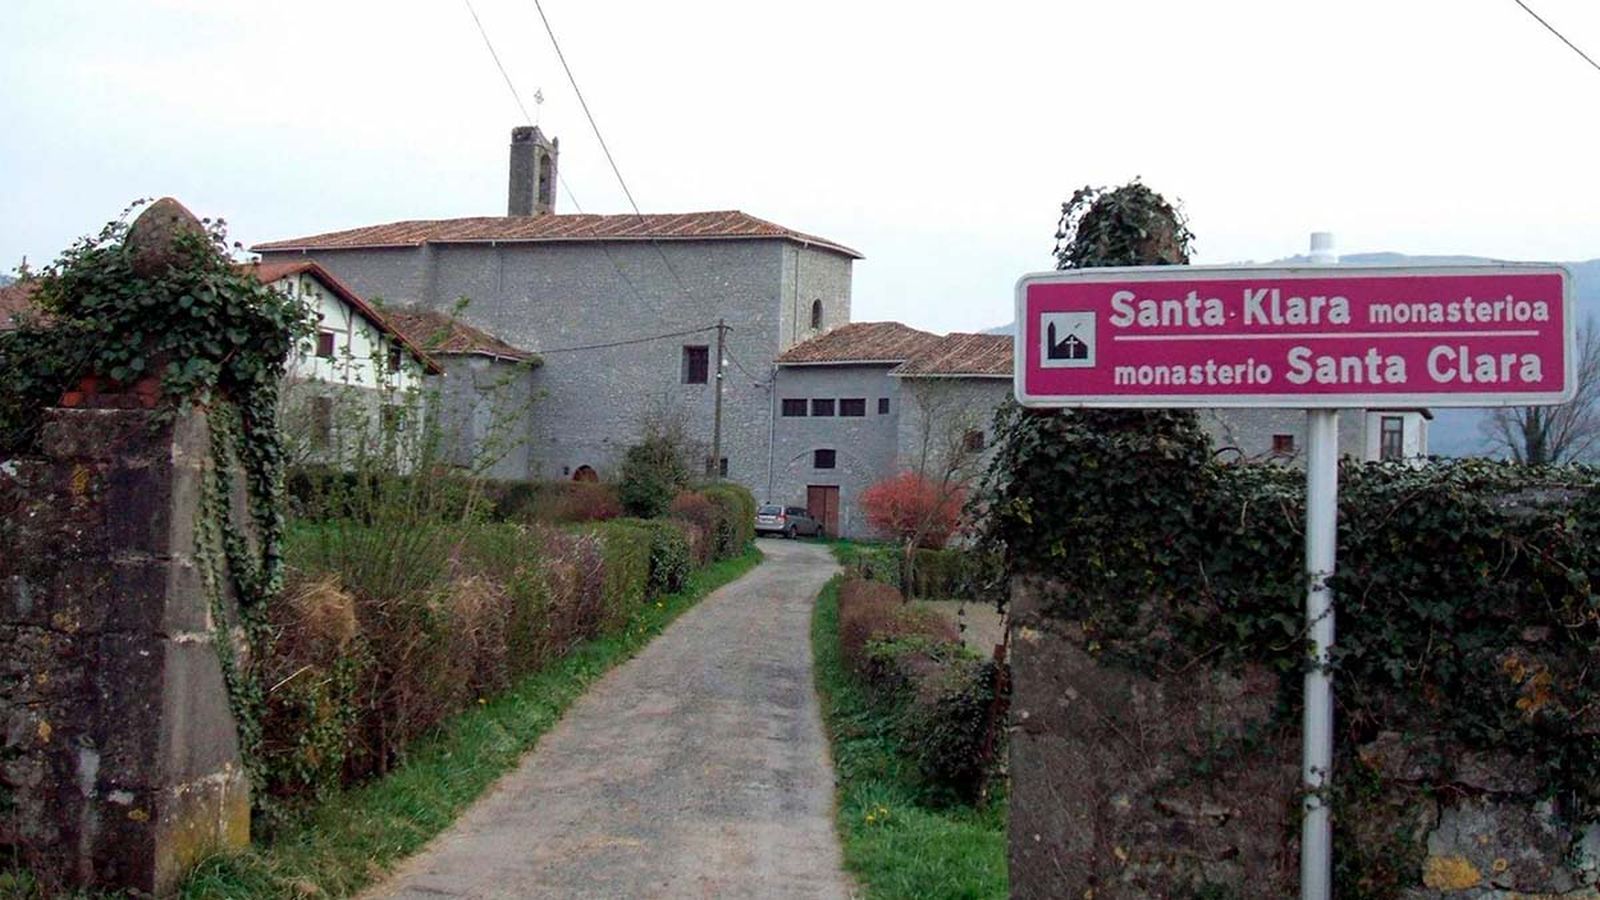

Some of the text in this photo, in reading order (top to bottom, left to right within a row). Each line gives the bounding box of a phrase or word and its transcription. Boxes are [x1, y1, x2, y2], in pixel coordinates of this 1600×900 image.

[1110, 289, 1549, 327] Santa Klara monasterioa
[1115, 345, 1543, 385] monasterio Santa Clara
